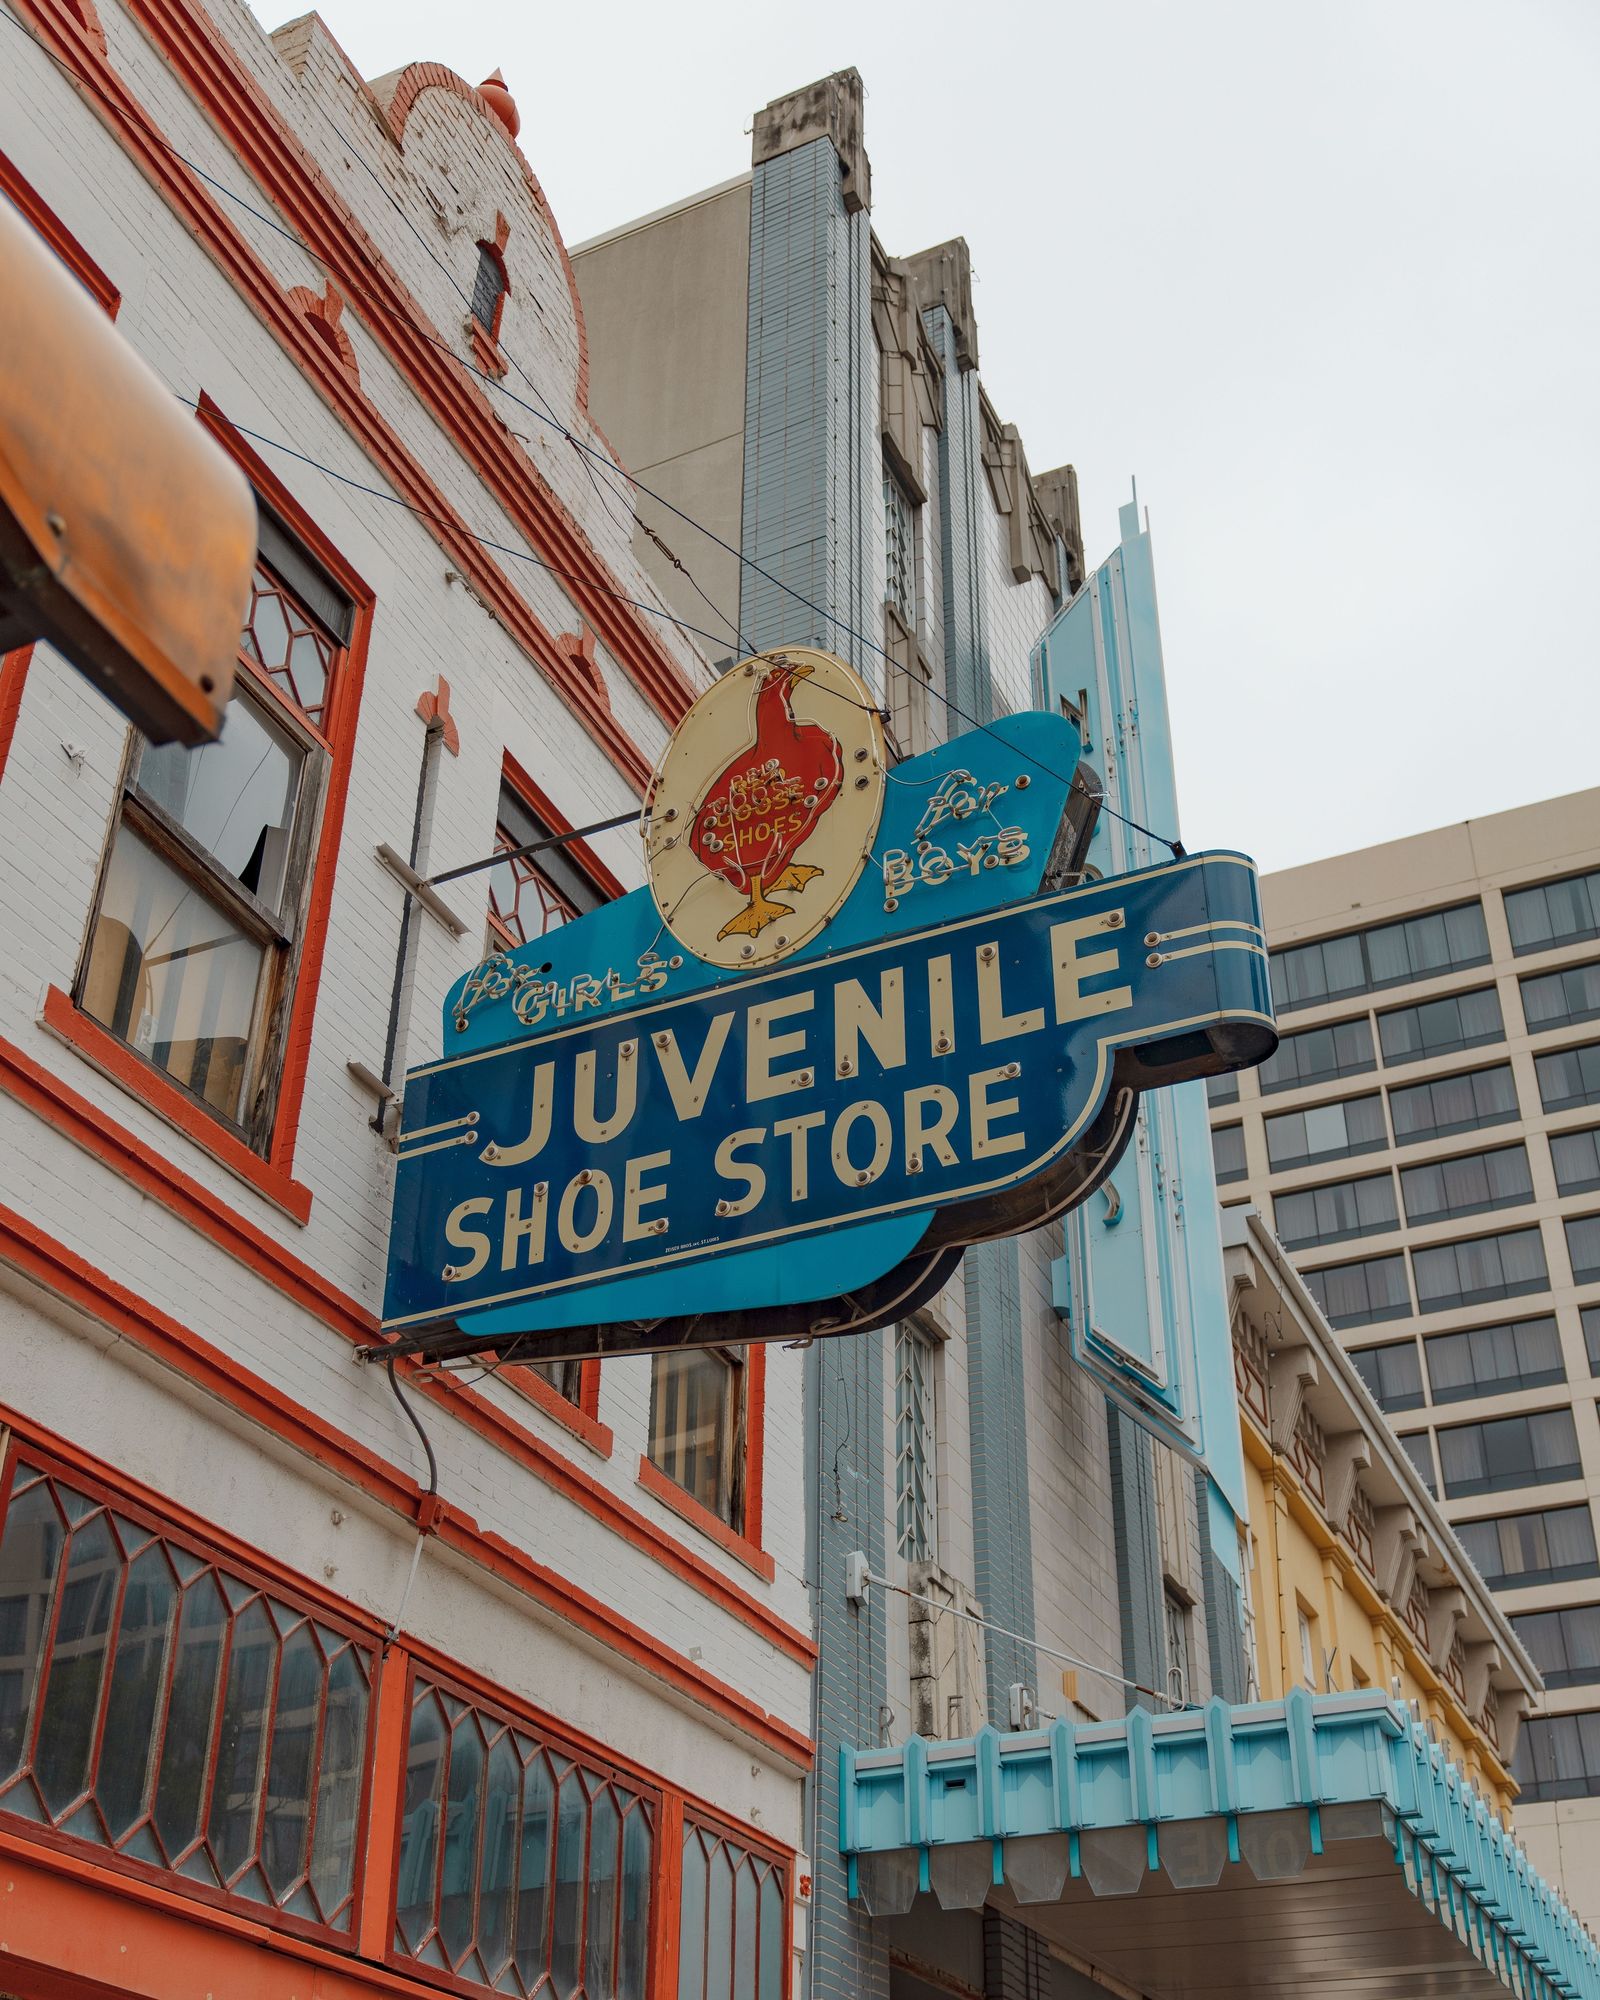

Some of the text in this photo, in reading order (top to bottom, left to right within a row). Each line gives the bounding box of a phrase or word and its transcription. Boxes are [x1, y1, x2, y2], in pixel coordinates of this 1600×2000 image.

[713, 776, 805, 827] GOOSE
[730, 764, 786, 796] RED
[722, 812, 803, 852] SHOES
[883, 826, 1031, 899] BOYS
[512, 951, 669, 1026] GIRLS
[478, 907, 1133, 1168] JUVENILE
[442, 1062, 1027, 1283] SHOE STORE
